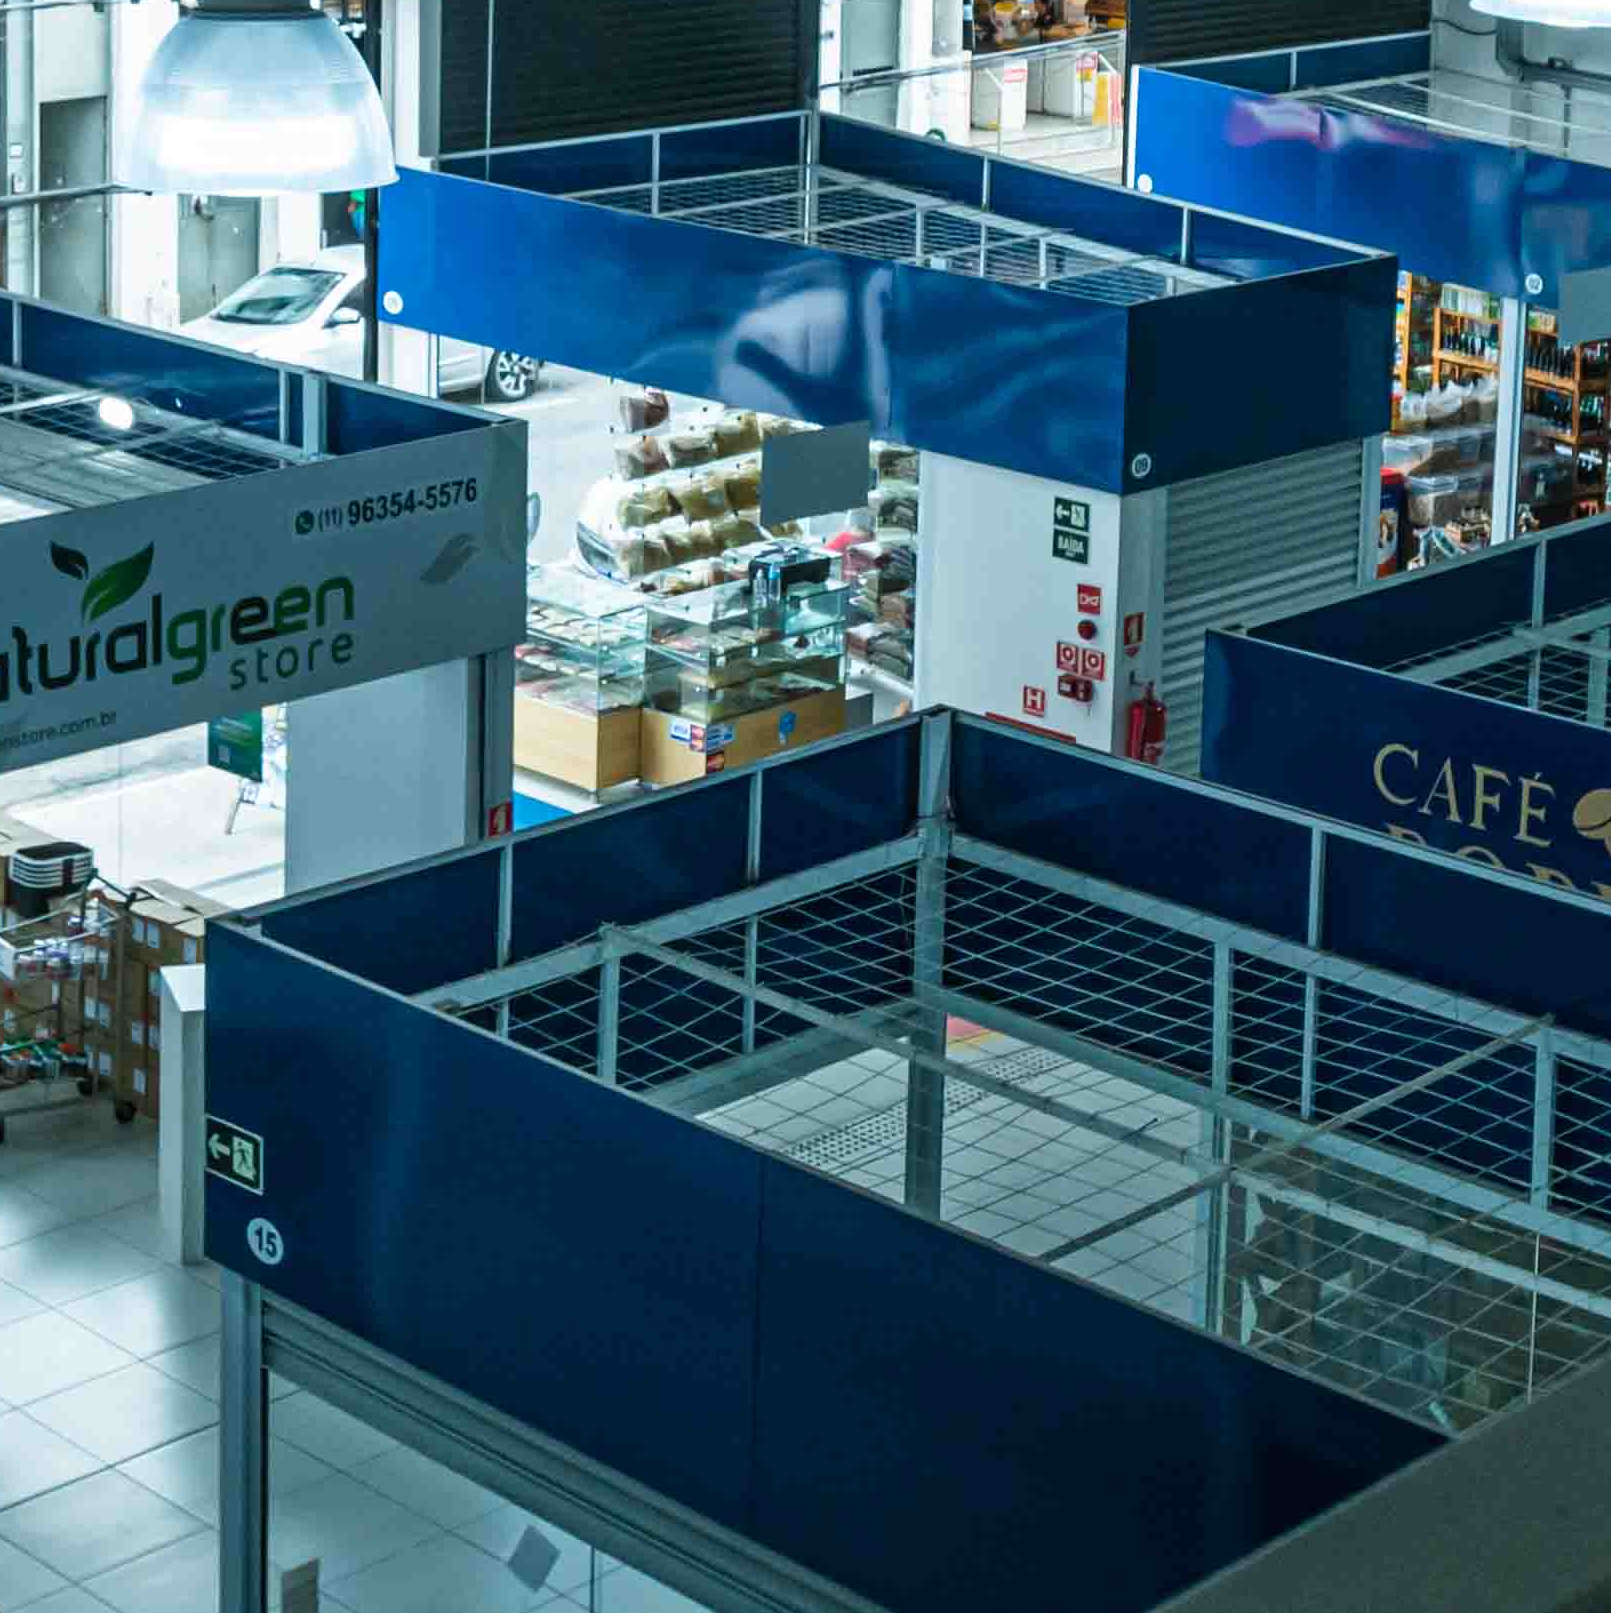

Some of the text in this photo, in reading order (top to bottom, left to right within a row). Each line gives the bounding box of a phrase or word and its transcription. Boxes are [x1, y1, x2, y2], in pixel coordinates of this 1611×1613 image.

[318, 477, 477, 531] (11) 96354-5576
[230, 630, 354, 690] store
[1373, 742, 1557, 848] CAFÉ
[254, 1225, 278, 1258] 15
